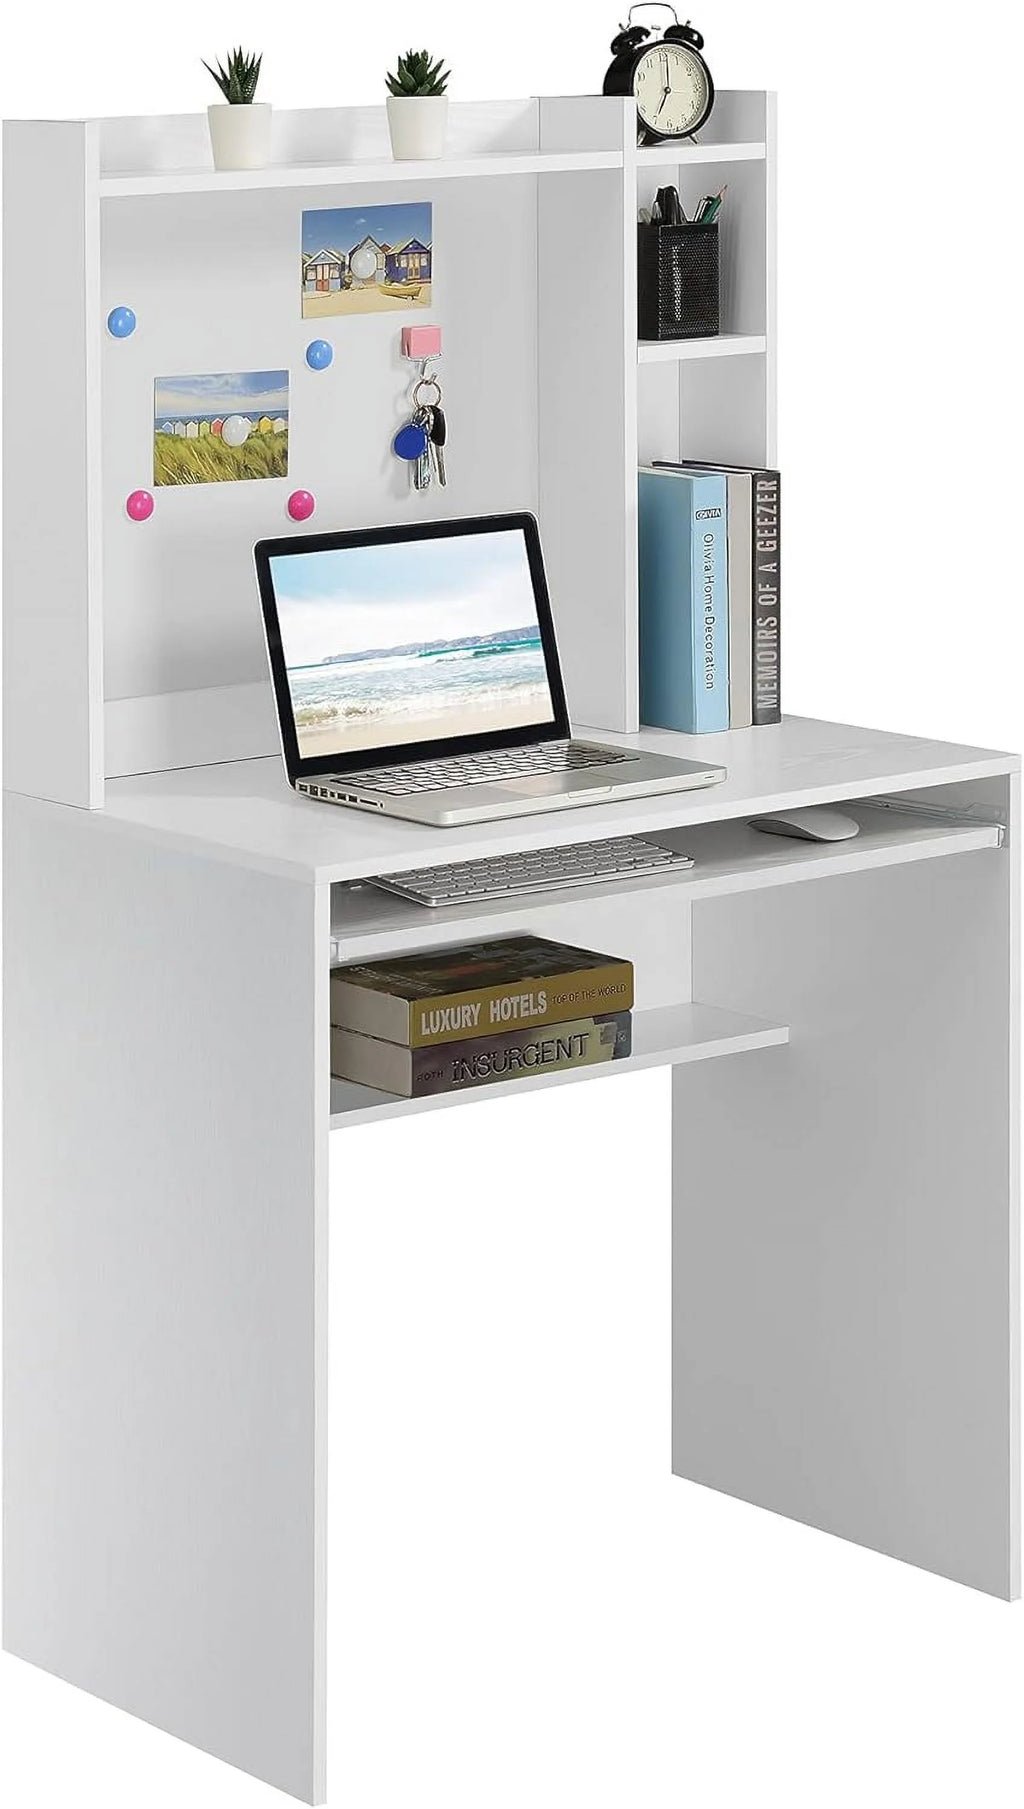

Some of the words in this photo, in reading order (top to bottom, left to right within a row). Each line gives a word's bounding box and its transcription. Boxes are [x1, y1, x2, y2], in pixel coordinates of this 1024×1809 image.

[757, 479, 778, 552] GEEZER
[703, 533, 714, 572] Olivia
[759, 562, 777, 573] A
[704, 575, 715, 613] Home
[759, 583, 778, 606] OF
[704, 616, 716, 690] Decoration
[757, 616, 778, 710] MEMOIRS
[421, 1003, 481, 1036] LUXURY
[489, 991, 548, 1024] HOTELS
[553, 993, 568, 1004] TOP
[569, 992, 580, 1002] OF
[581, 989, 596, 1000] THE
[597, 983, 627, 997] WORLD
[451, 1032, 590, 1084] INSURGENT
